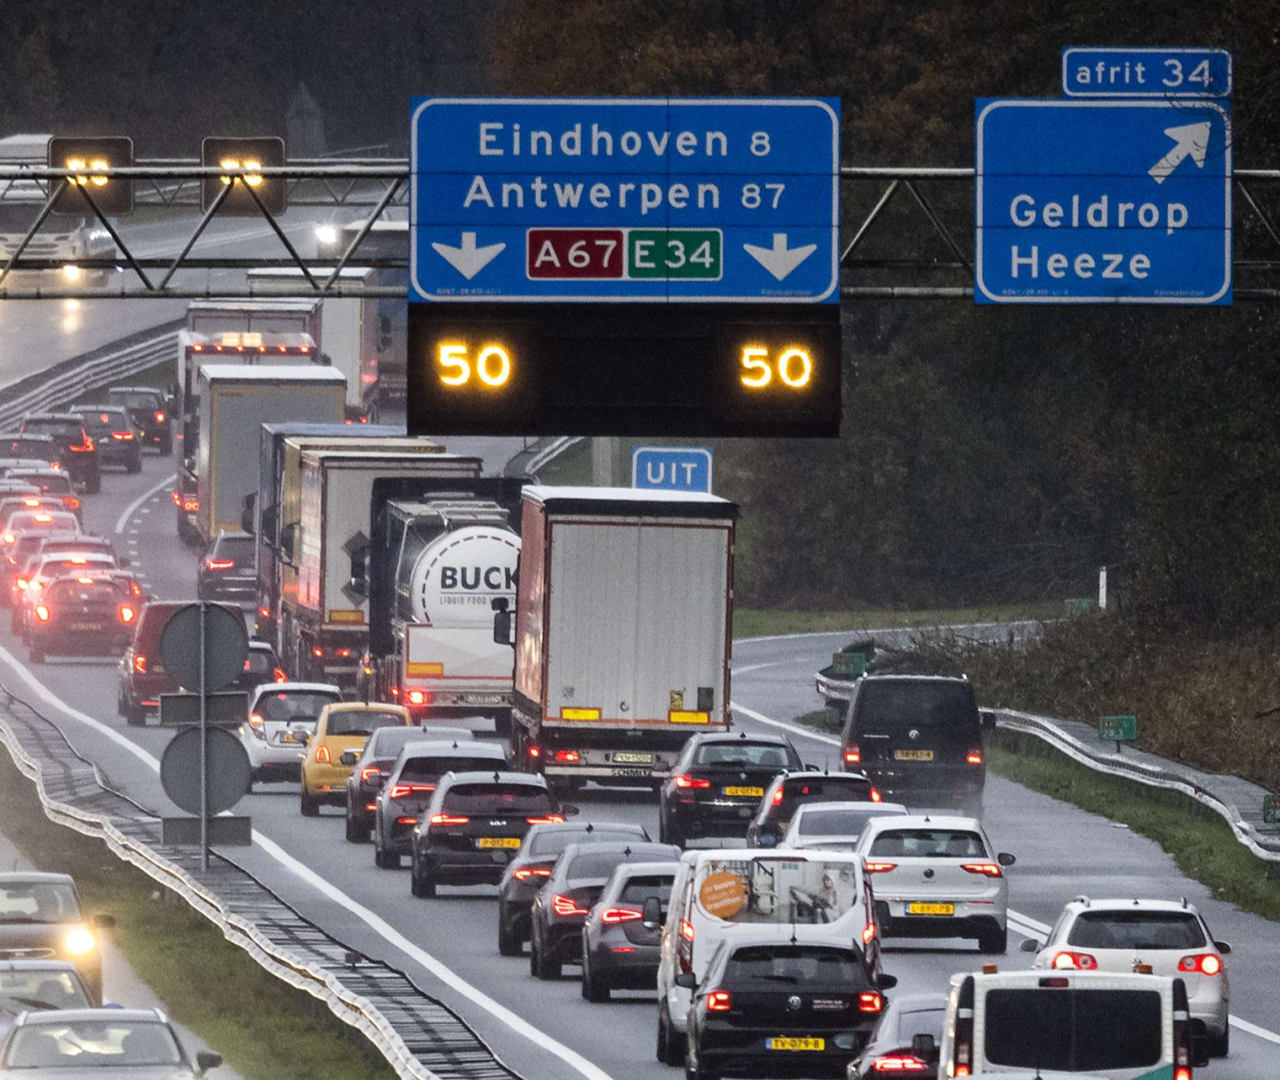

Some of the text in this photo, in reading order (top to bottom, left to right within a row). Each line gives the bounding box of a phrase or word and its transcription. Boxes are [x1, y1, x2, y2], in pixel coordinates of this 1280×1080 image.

[1076, 60, 1213, 87] afrit 34
[480, 122, 771, 156] Eindhoven 8
[464, 176, 786, 215] Antwerpen 87
[1010, 194, 1189, 235] Geldrop
[534, 240, 618, 268] A67
[1011, 245, 1151, 279] Heeze
[439, 345, 511, 387] 50
[740, 347, 812, 388] 50
[647, 461, 698, 485] UIT
